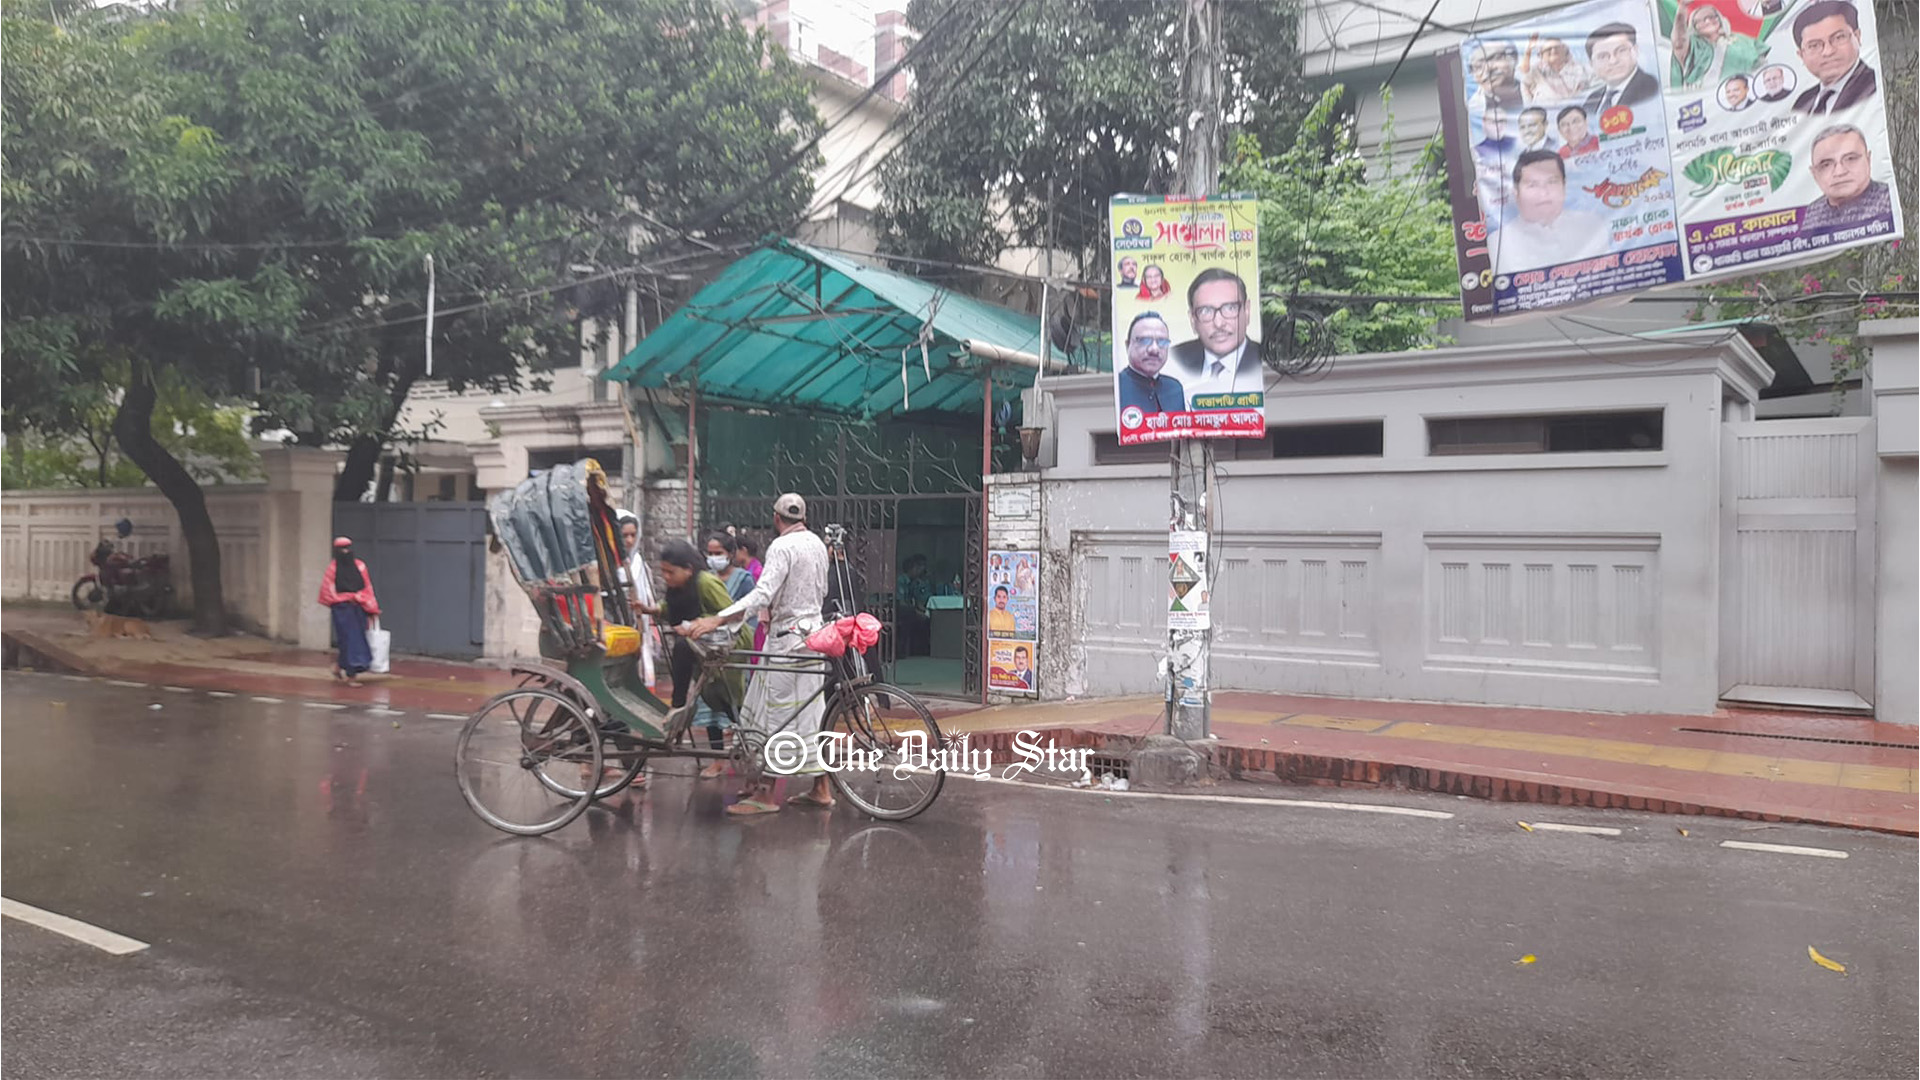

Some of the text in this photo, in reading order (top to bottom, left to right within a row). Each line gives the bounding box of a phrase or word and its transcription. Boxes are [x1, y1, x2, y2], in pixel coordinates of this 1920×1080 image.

[1154, 220, 1226, 249] সম্মেলন
[1141, 252, 1166, 264] সফল
[1196, 394, 1235, 408] সভাপতি
[1145, 411, 1169, 430] হাজী
[1172, 415, 1192, 428] মোঃ
[1230, 412, 1259, 428] আলম
